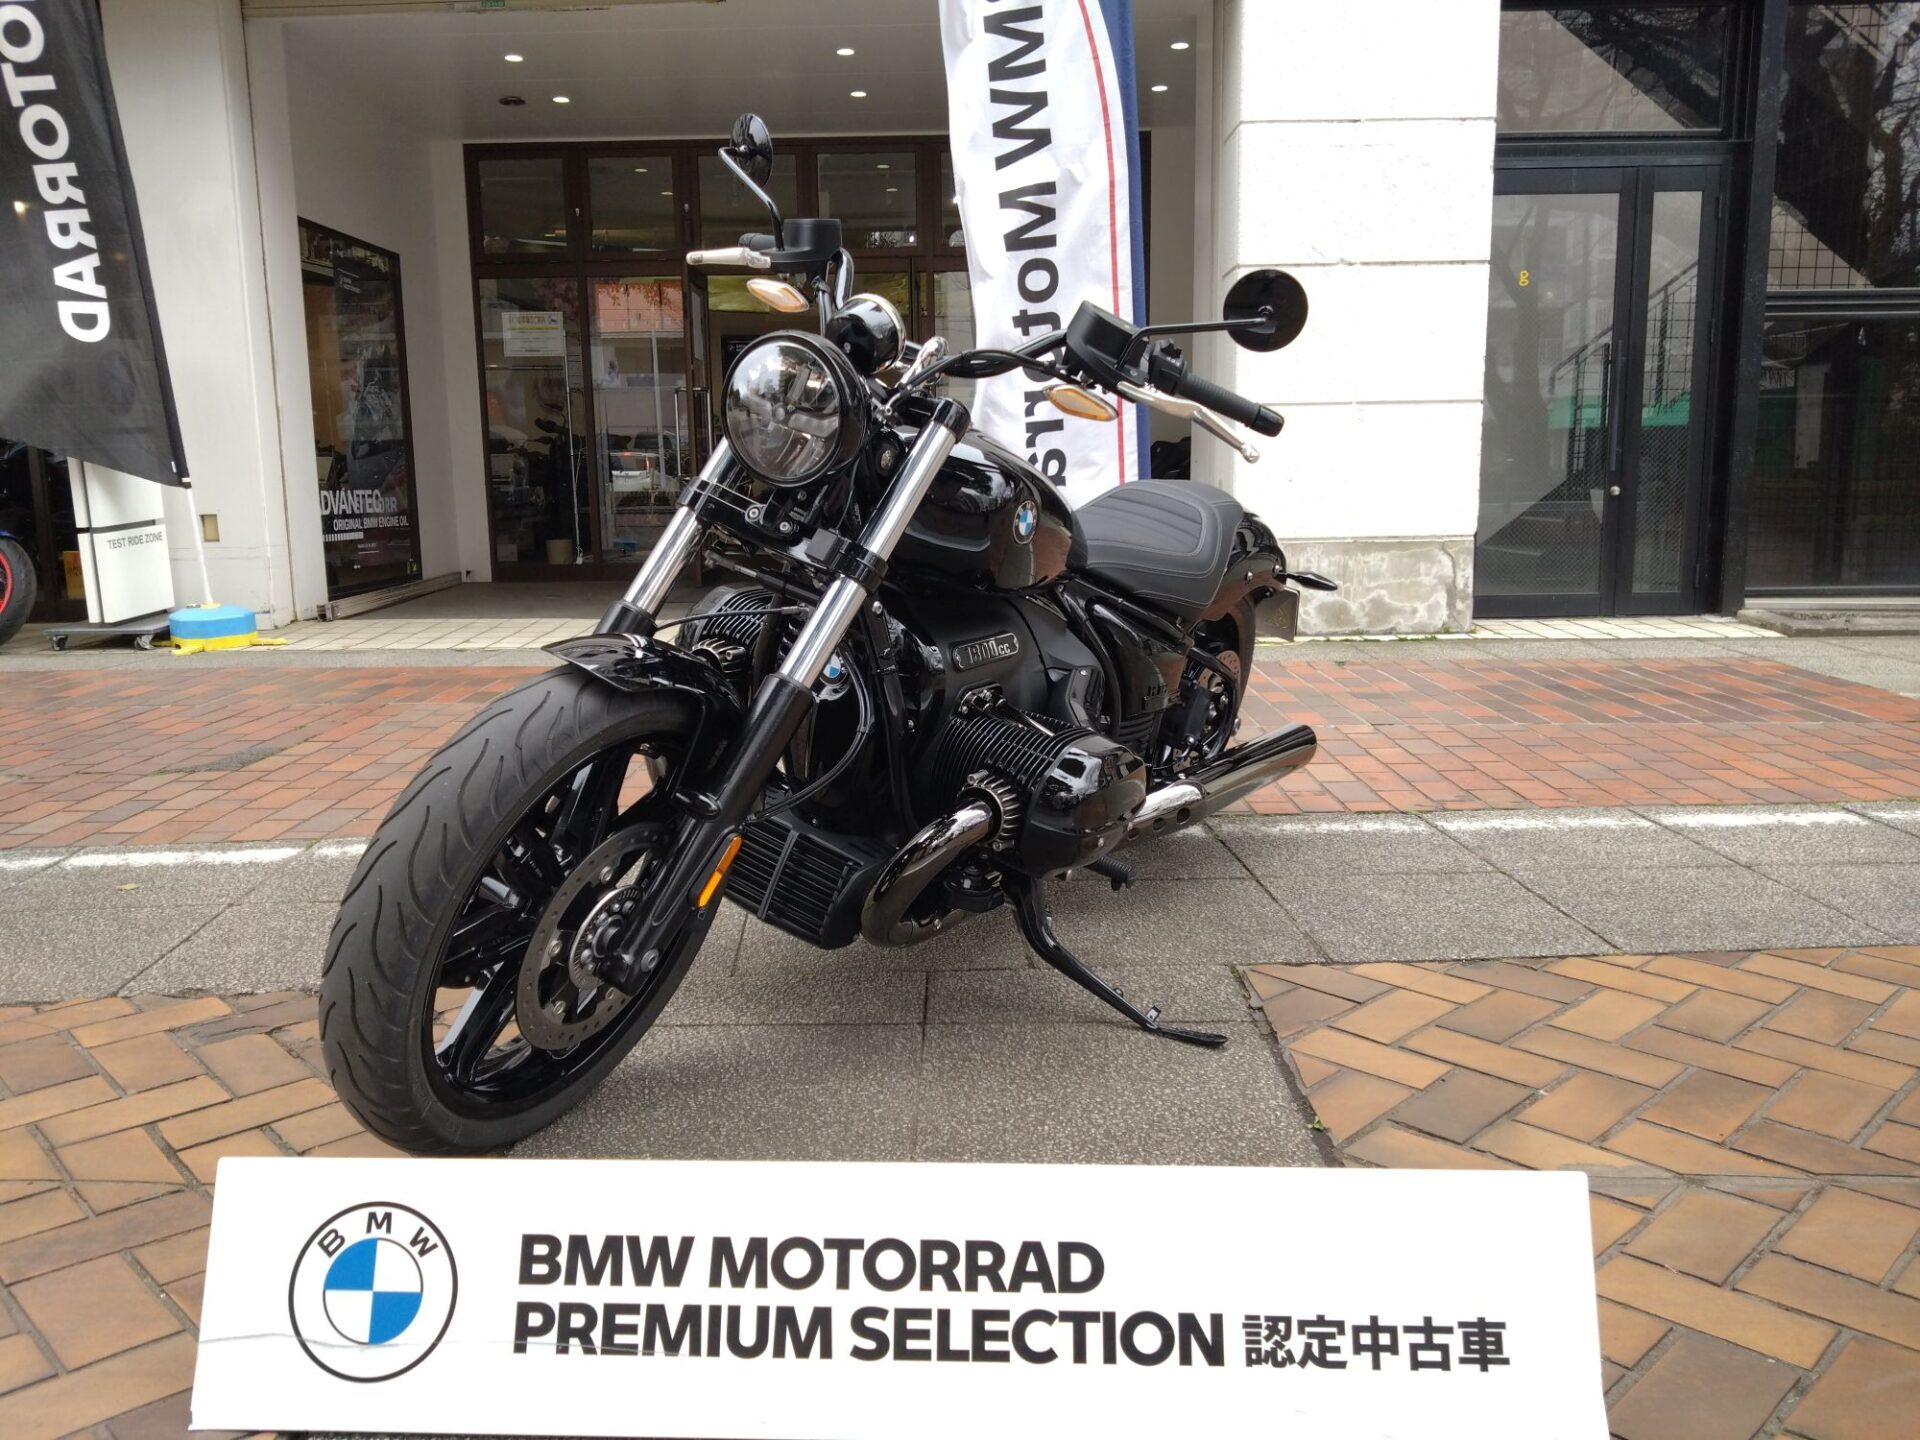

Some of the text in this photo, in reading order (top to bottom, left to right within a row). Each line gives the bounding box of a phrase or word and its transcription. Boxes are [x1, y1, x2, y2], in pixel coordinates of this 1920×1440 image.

[107, 531, 163, 550] TEST RIDE ZONE
[333, 515, 409, 531] ORIGINAL BMW ENGINE OIL
[317, 1211, 439, 1258] BMW
[519, 1234, 1105, 1294] BMW MOTORRAD
[514, 1302, 1510, 1373] PREMIUM SELECTION 認定中古車
